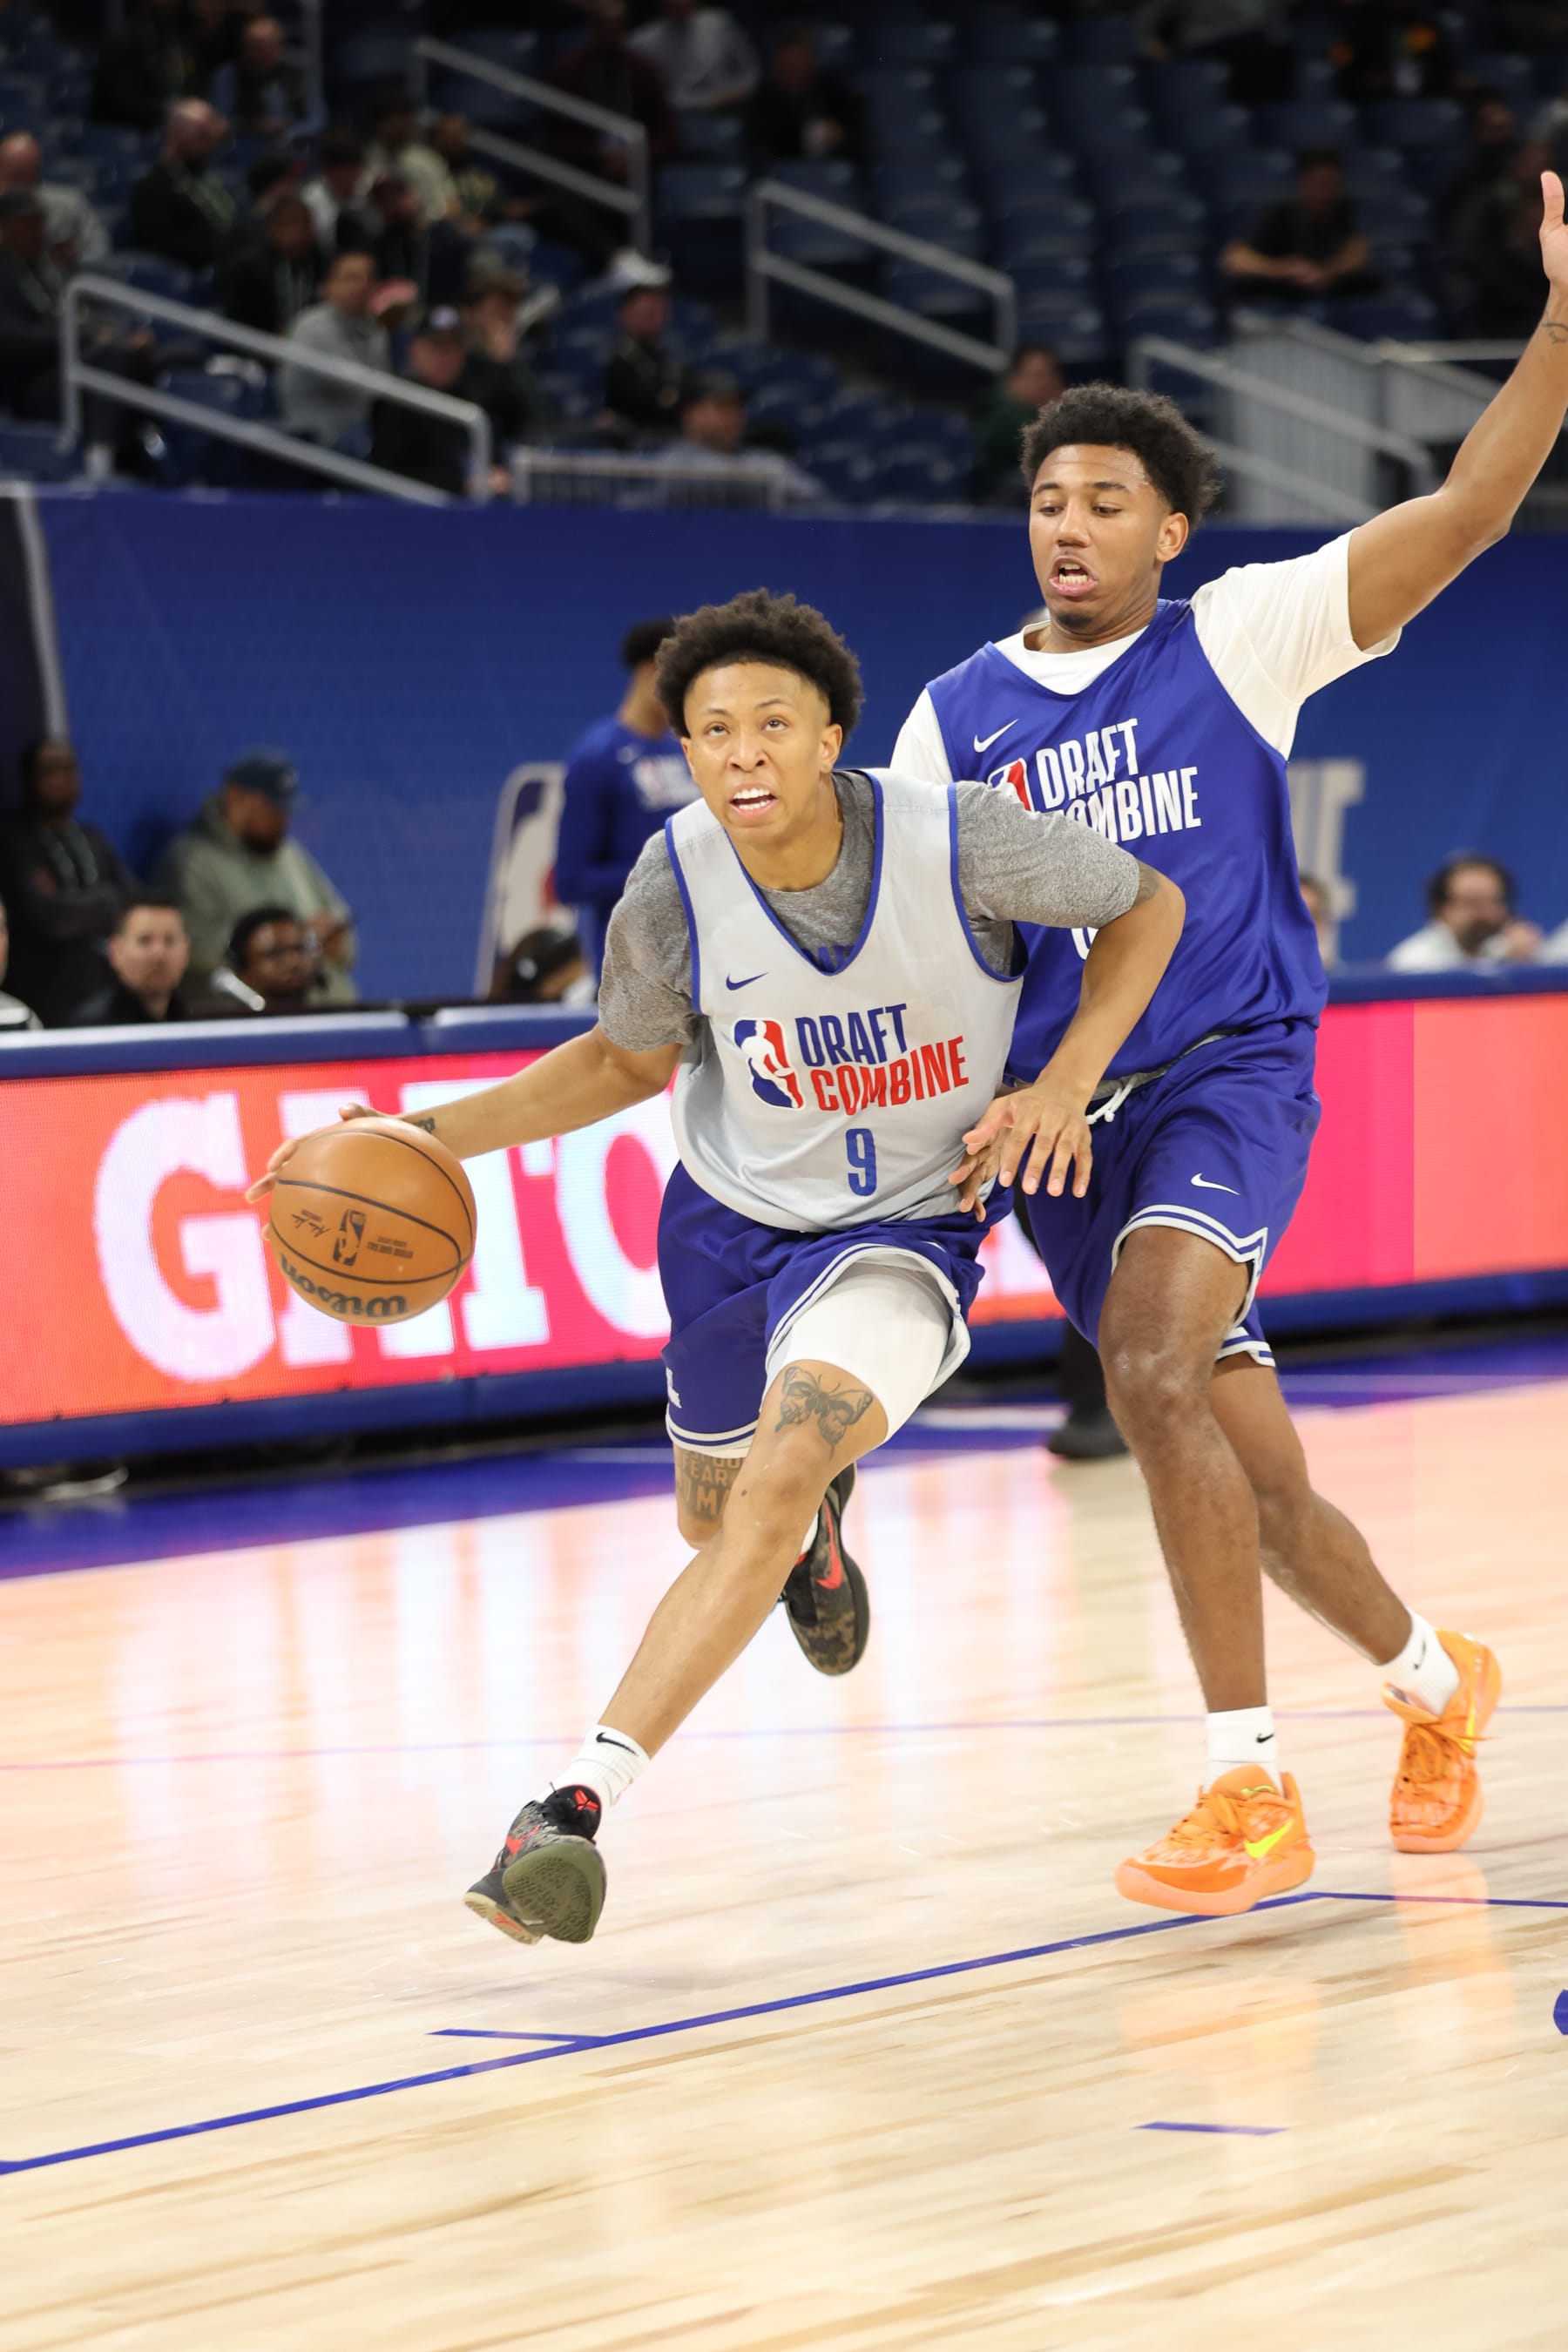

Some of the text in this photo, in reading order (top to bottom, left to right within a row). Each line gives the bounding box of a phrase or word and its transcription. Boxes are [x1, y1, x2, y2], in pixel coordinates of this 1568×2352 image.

[1035, 718, 1139, 809] DRAFT
[1051, 767, 1202, 844] MBINE
[794, 1003, 908, 1067] DRAFT
[810, 1035, 969, 1116] COMBINE
[845, 1128, 877, 1197] 9
[280, 1253, 409, 1317] Wilson
